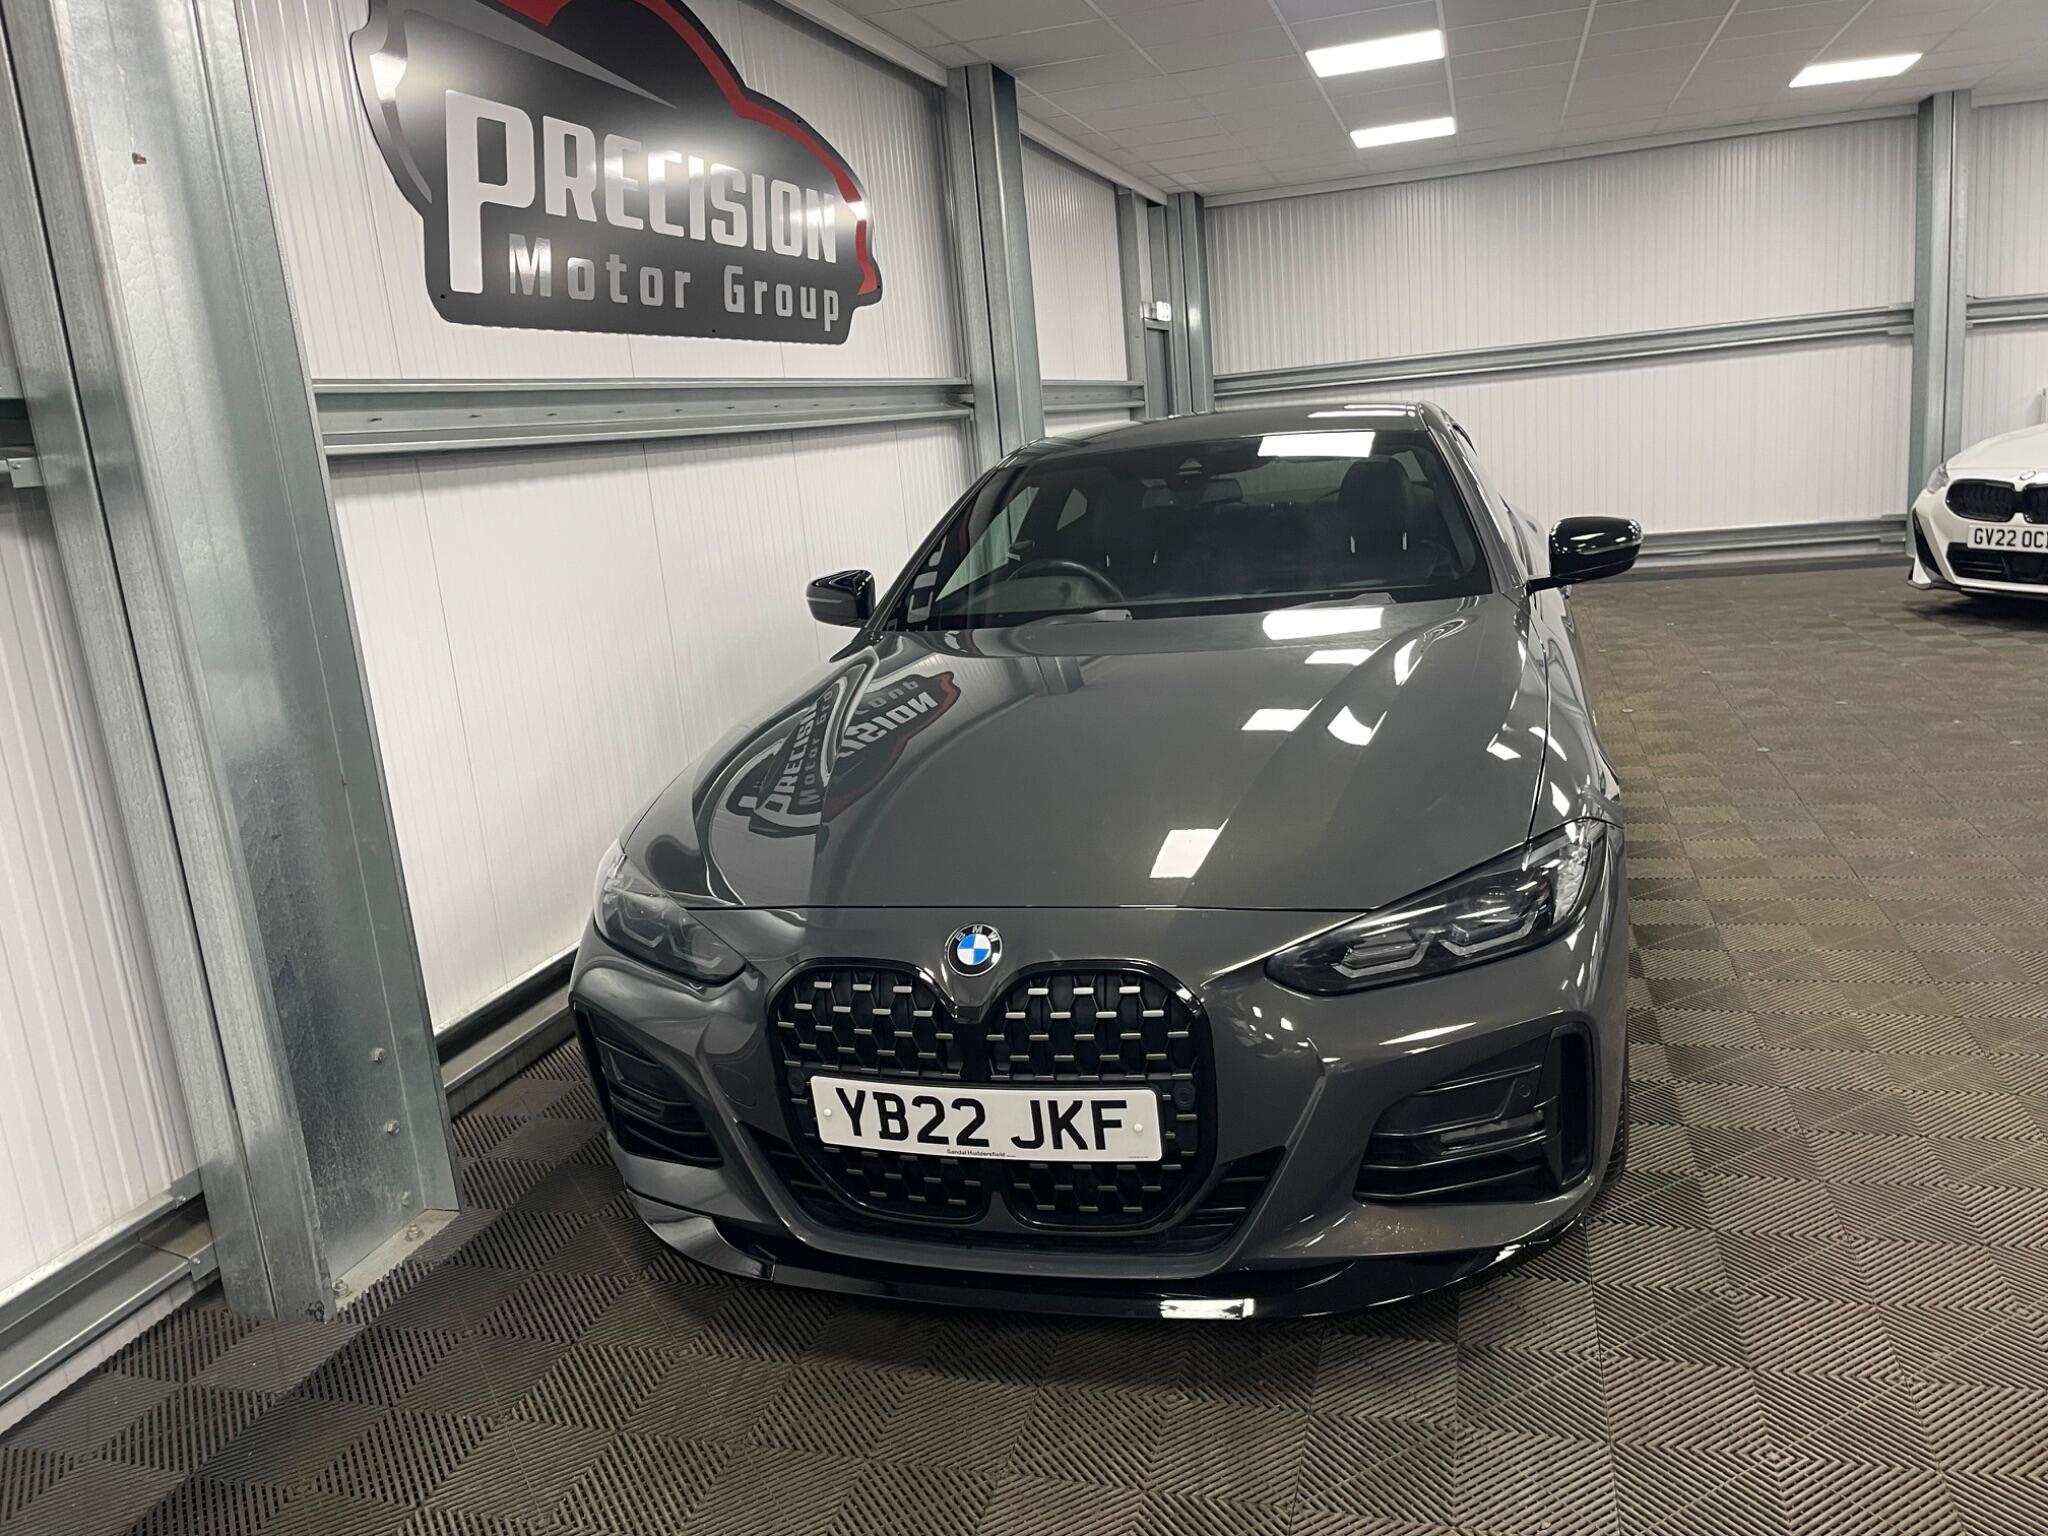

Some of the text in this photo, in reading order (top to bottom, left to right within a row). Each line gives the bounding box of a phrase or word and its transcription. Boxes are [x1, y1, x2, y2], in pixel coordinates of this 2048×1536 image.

[445, 89, 838, 295] PRECISION
[508, 233, 840, 332] Motor Group
[1973, 527, 2048, 549] GV22 OC
[954, 924, 999, 942] BMW
[835, 1087, 1128, 1151] YB22 JKF
[967, 1150, 1006, 1158] Huddersfield
